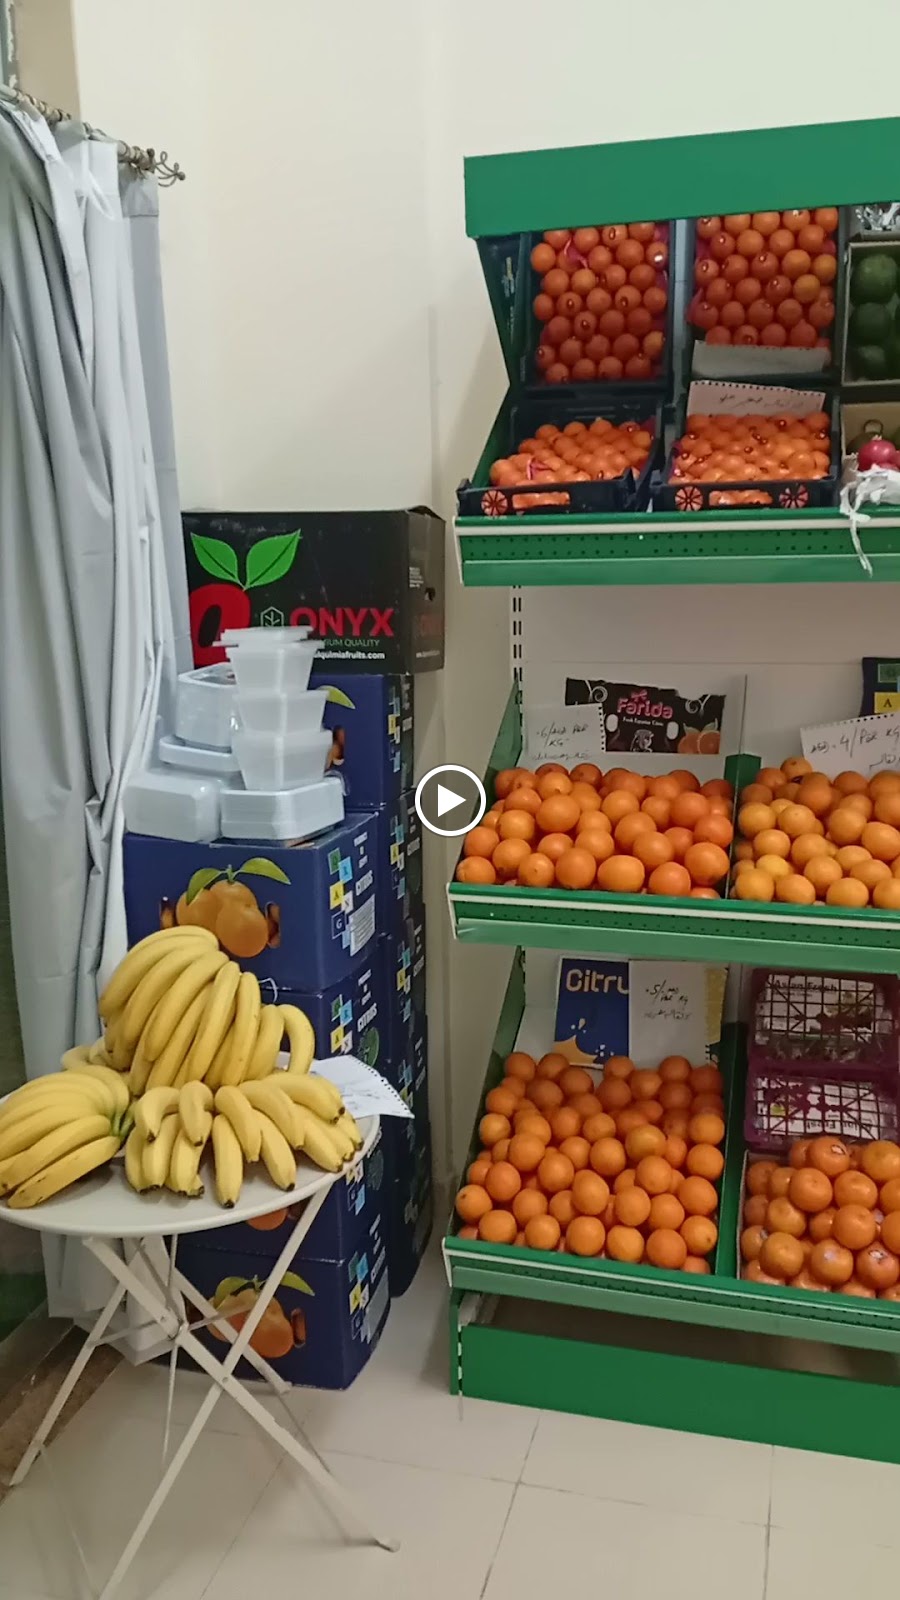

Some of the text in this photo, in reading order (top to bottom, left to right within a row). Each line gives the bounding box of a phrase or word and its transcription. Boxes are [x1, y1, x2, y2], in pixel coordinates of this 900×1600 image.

[289, 607, 394, 637] ONYX
[344, 639, 380, 648] QUALITY
[617, 698, 673, 719] Farida
